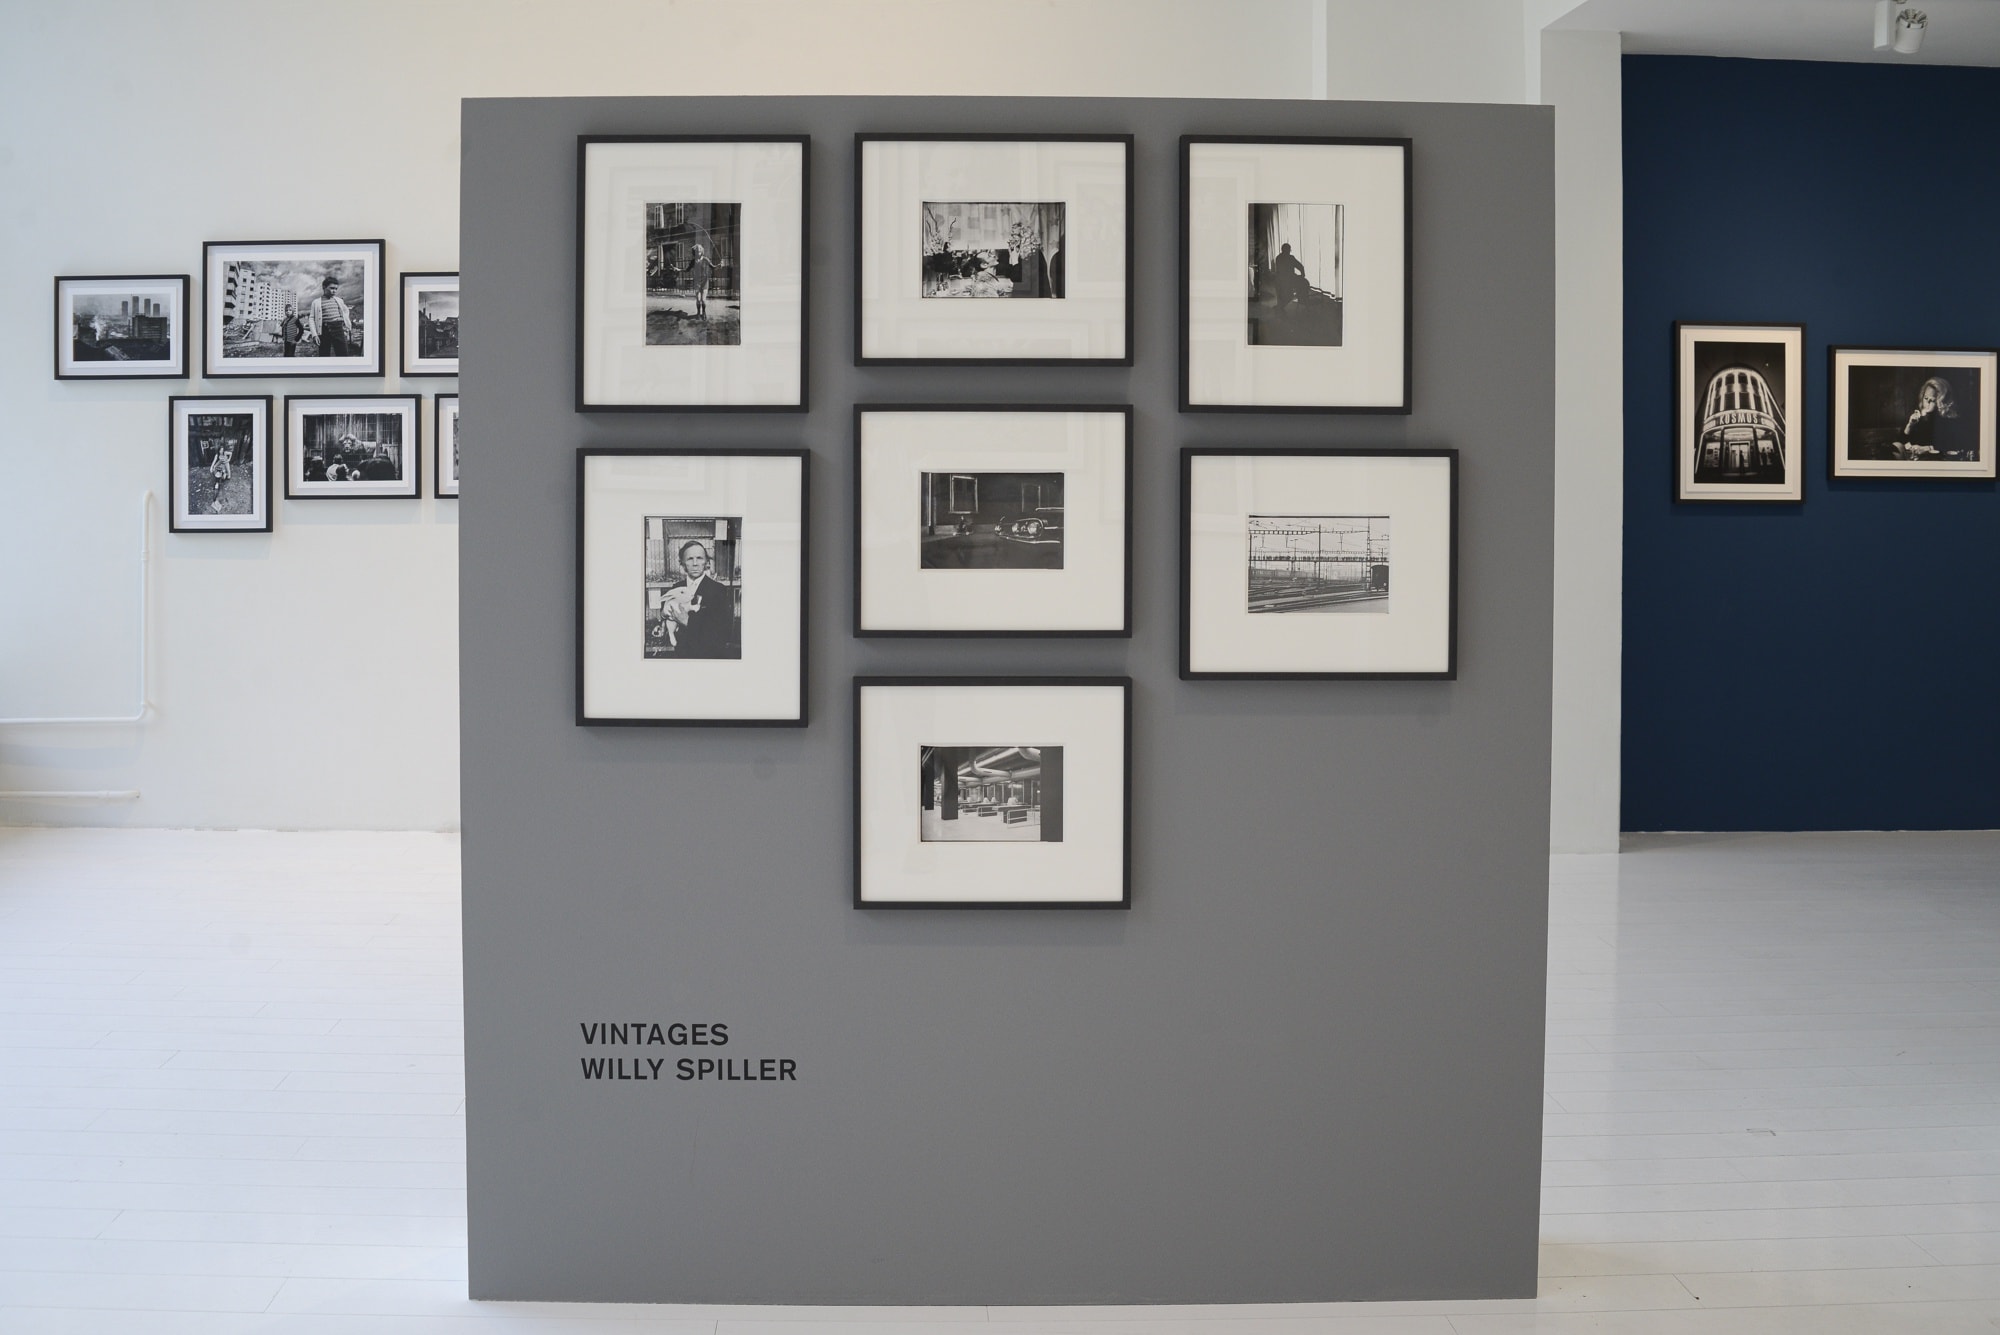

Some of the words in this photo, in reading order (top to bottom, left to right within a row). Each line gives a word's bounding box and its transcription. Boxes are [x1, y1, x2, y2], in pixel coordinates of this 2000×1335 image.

[1719, 412, 1758, 425] KOSMOS
[580, 1022, 729, 1046] VINTAGES
[580, 1057, 665, 1081] WILLY
[676, 1058, 798, 1081] SPILLER
